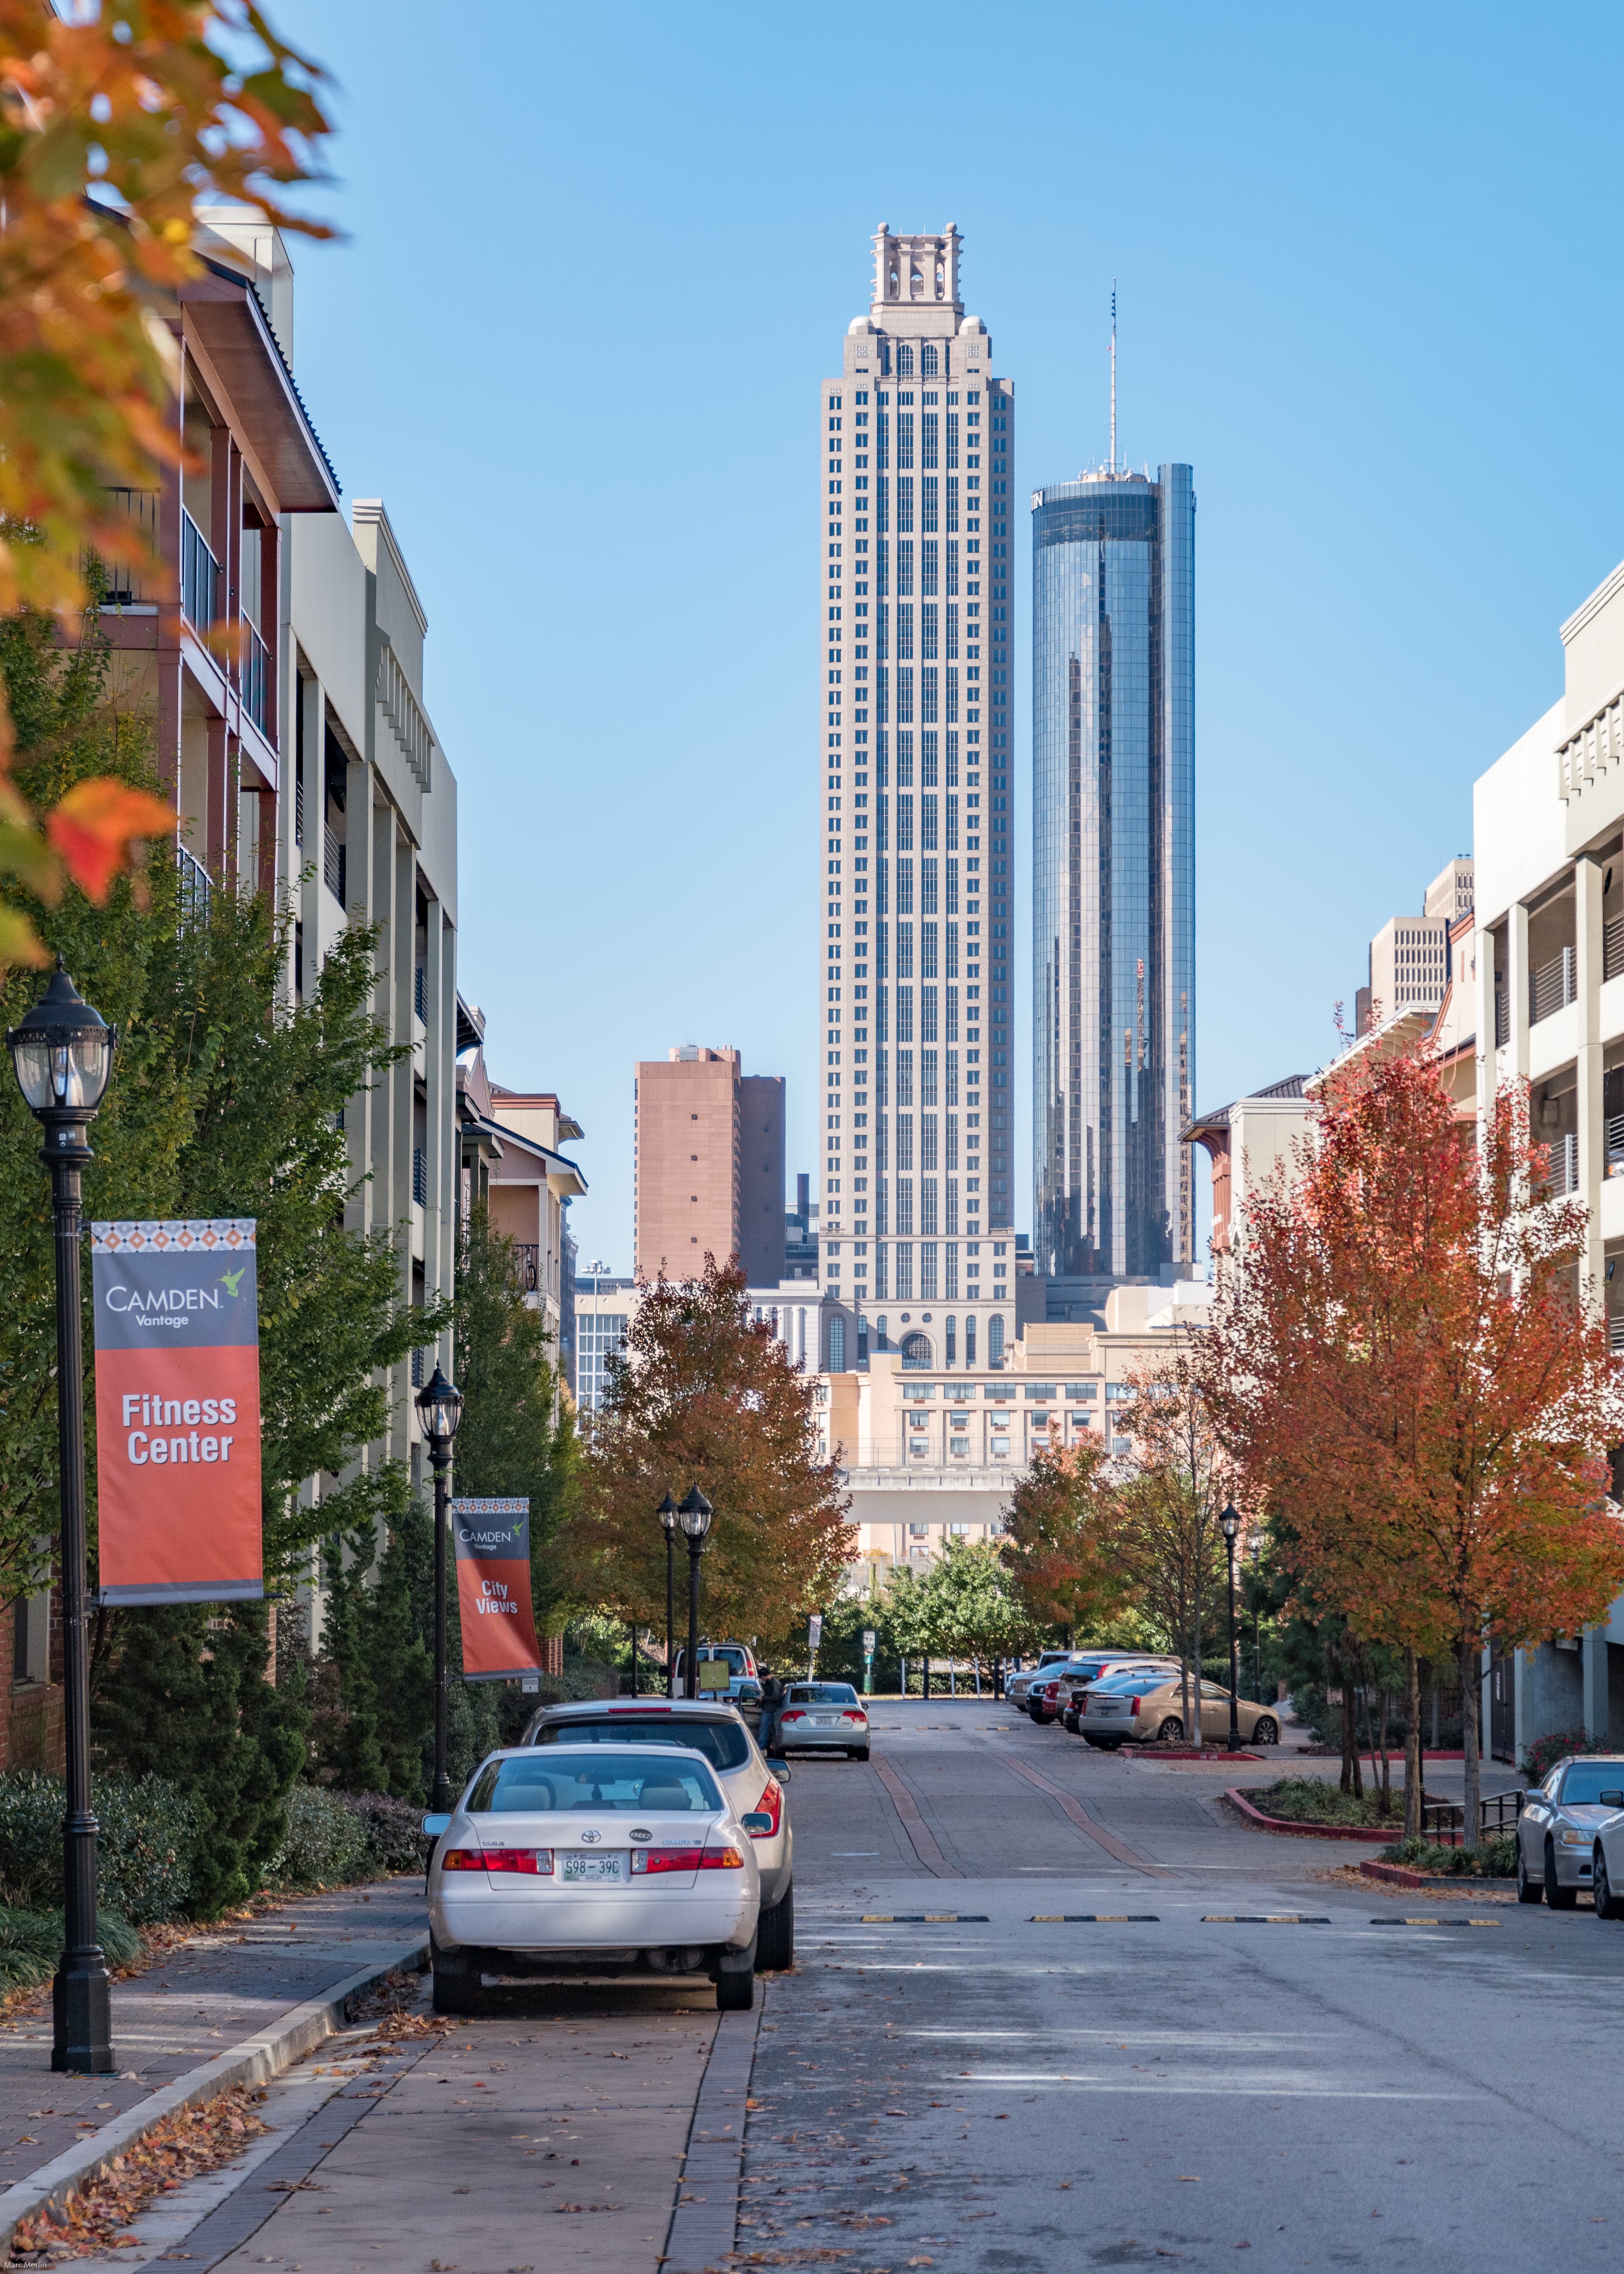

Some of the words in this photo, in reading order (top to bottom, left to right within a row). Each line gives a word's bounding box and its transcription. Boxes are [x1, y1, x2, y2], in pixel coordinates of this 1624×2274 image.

[106, 1285, 218, 1312] CAMDEN
[135, 1315, 189, 1329] Vantage
[122, 1394, 237, 1426] Fitness
[128, 1431, 233, 1464] Center
[459, 1529, 511, 1542] CAMDEN
[482, 1580, 508, 1600] City
[476, 1598, 518, 1615] Views
